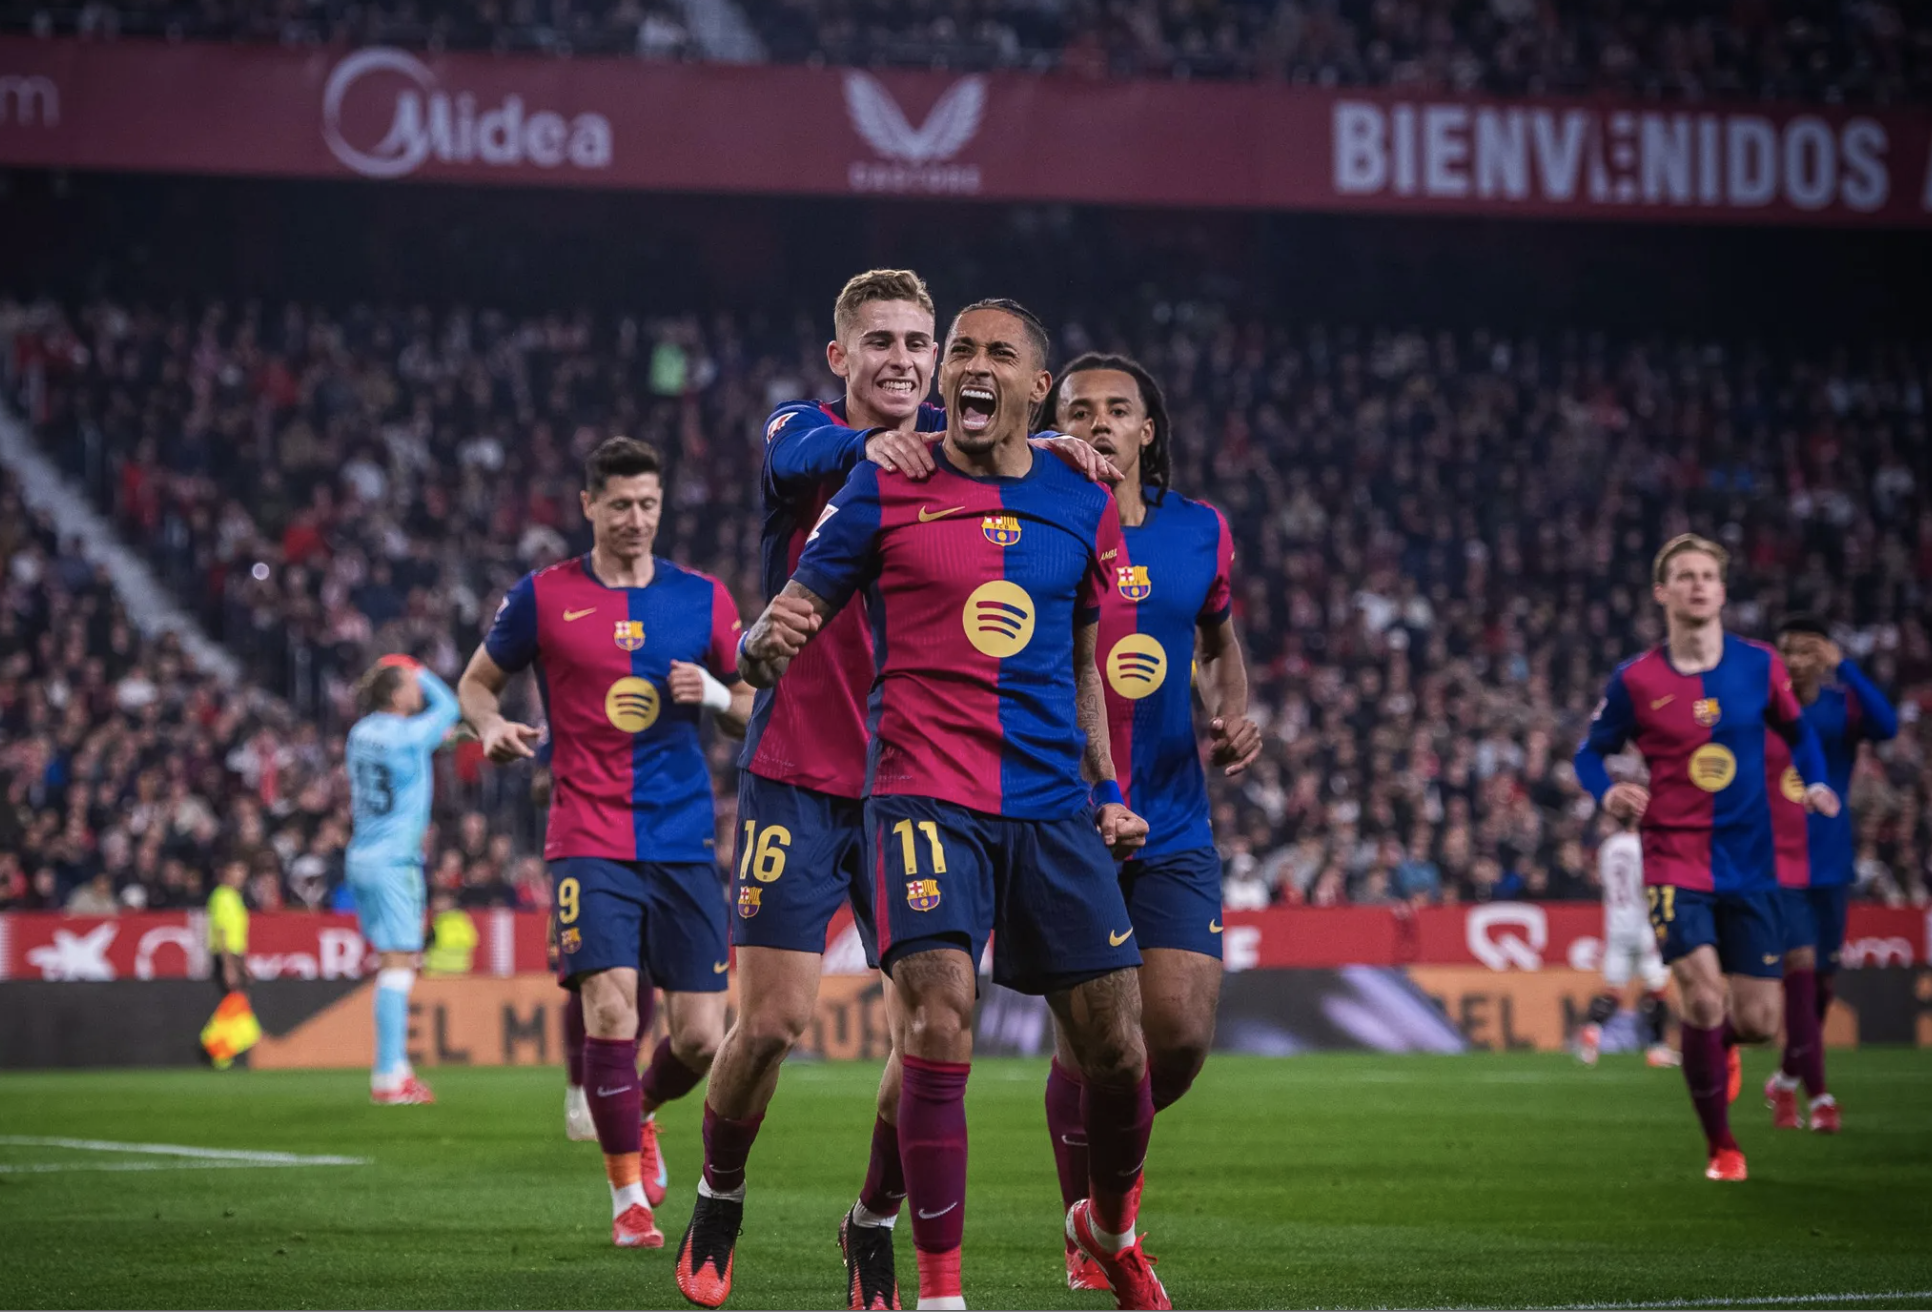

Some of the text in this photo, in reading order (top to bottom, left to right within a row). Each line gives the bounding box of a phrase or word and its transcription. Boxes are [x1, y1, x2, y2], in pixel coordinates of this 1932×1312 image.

[370, 88, 613, 172] Midea
[1332, 99, 1890, 212] BIENVENIDOS
[739, 820, 791, 882] 16
[892, 818, 947, 875] 11
[559, 877, 580, 924] 9
